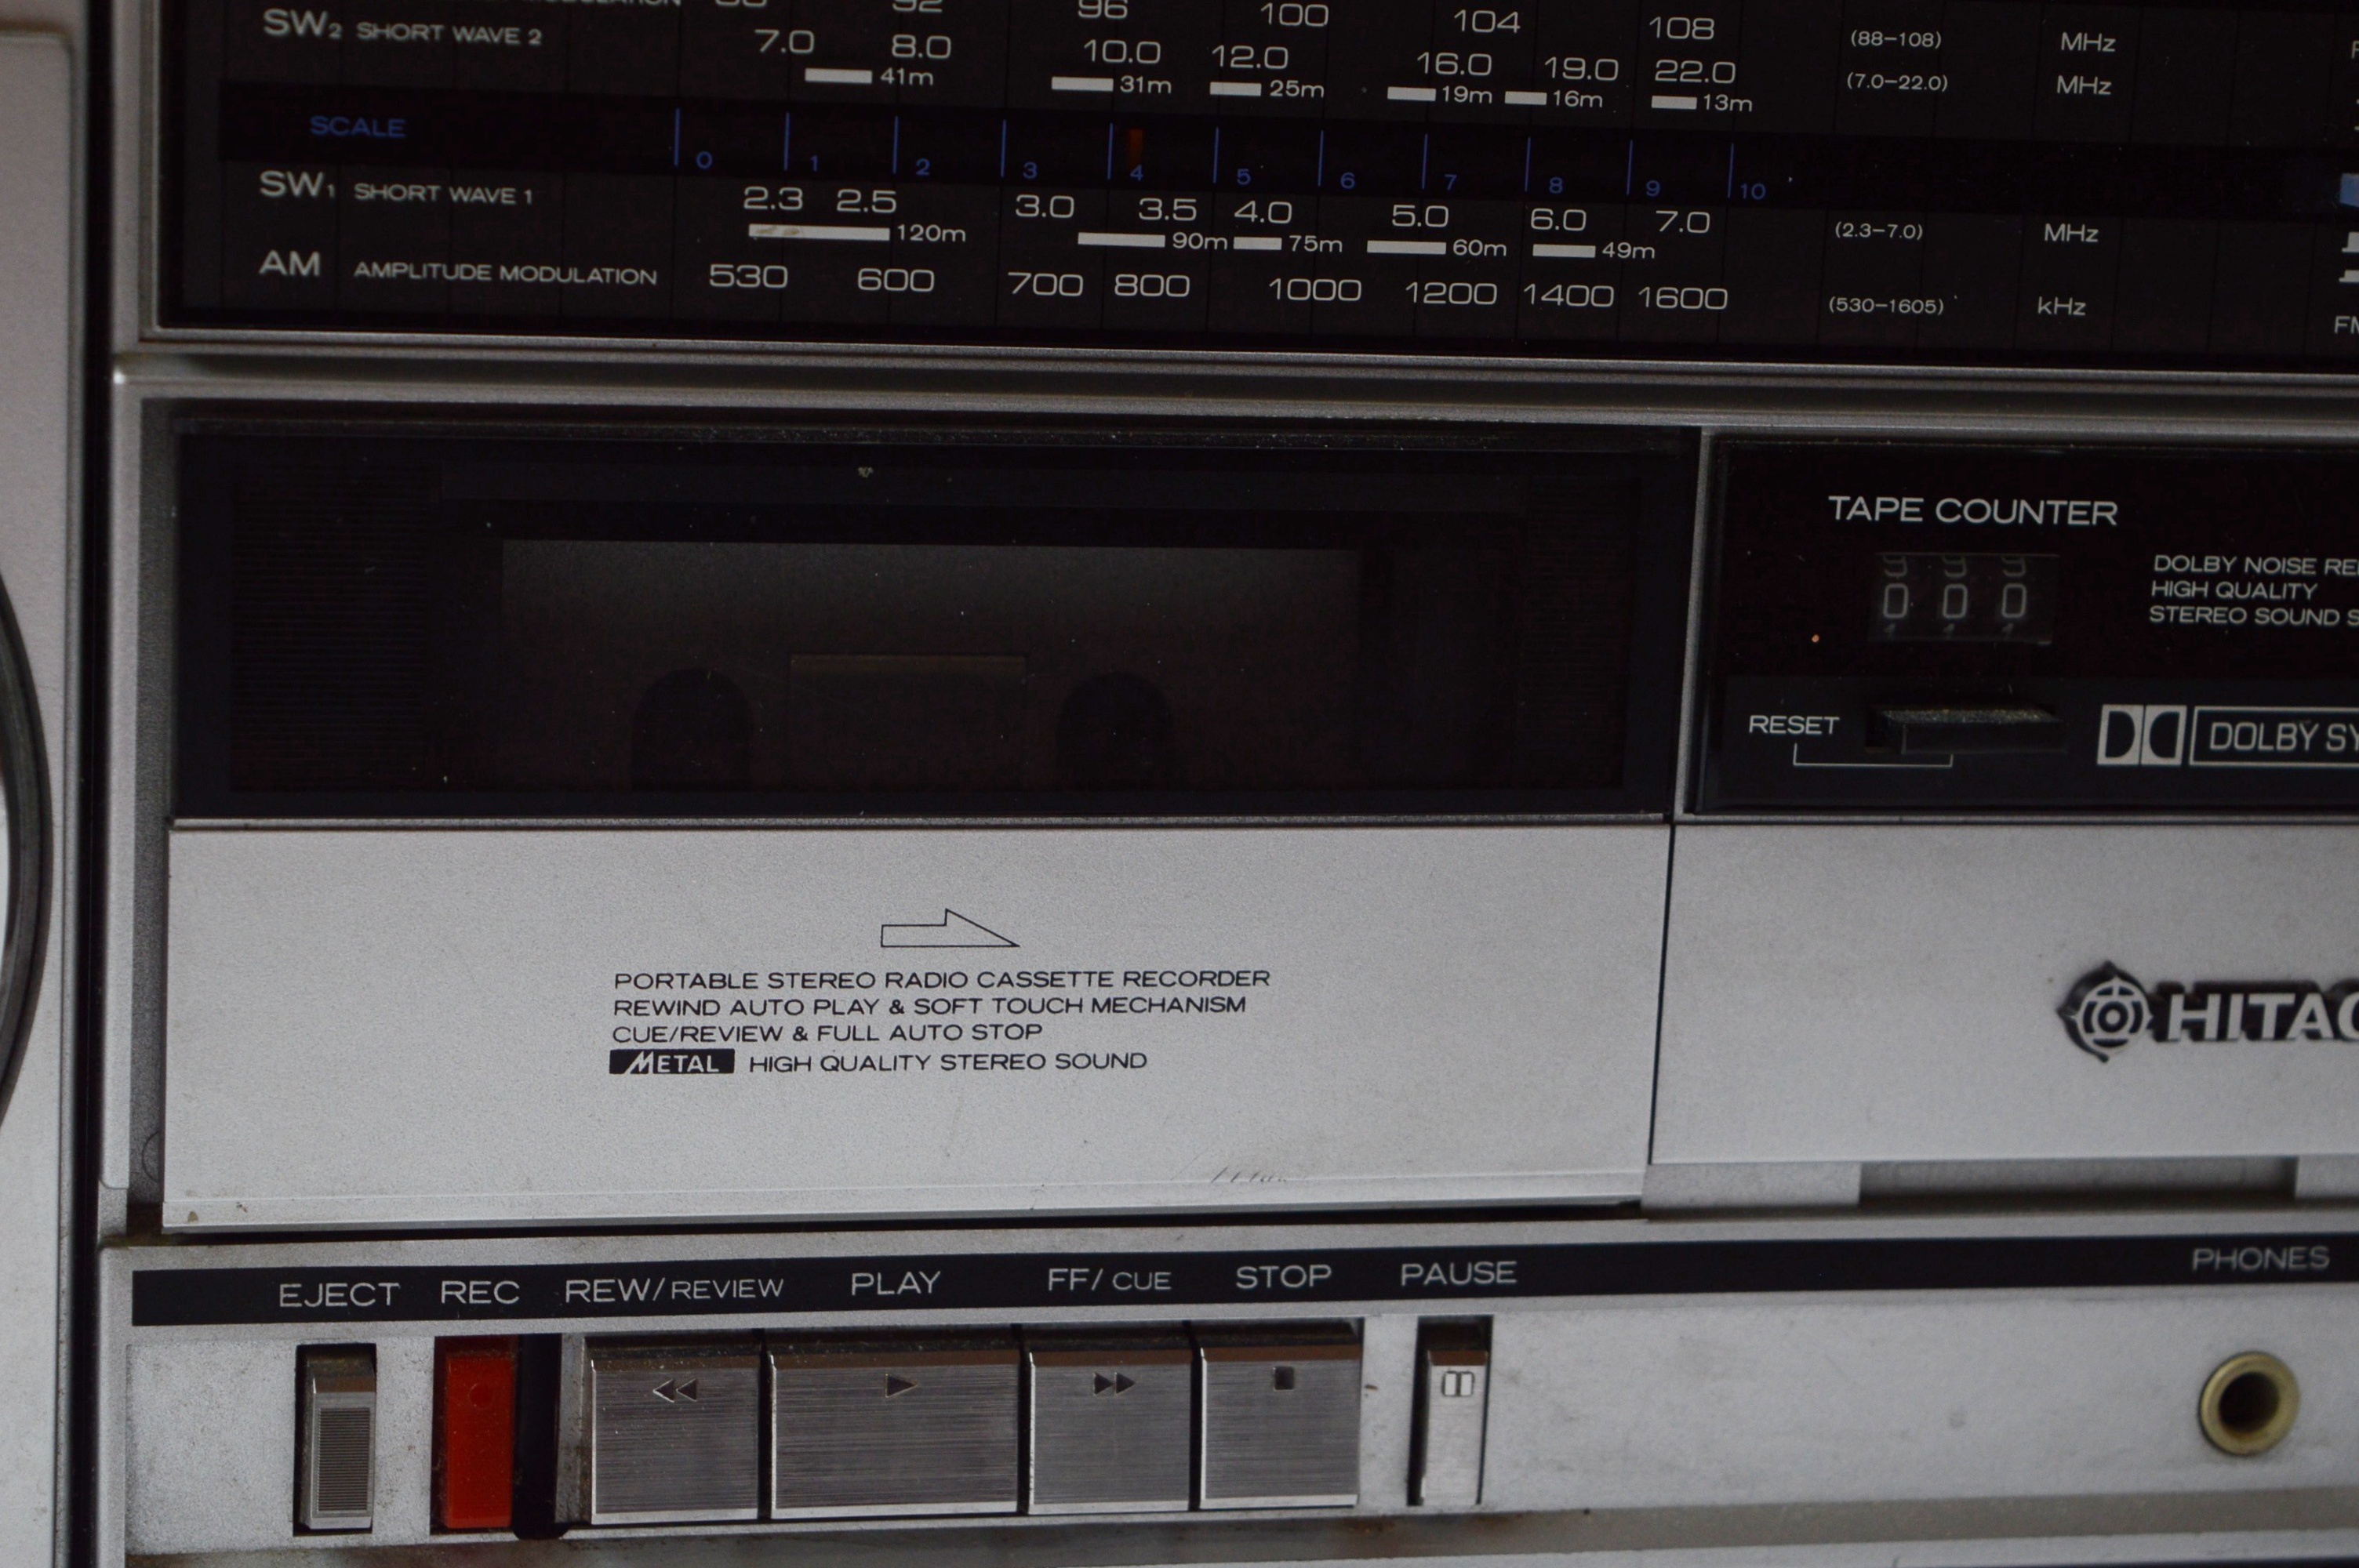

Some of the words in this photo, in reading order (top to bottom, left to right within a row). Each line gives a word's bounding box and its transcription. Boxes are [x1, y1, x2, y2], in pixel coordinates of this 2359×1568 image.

[1078, 0, 1129, 20] 96
[1260, 2, 1329, 27] 100
[1454, 9, 1521, 34] 104
[1649, 16, 1715, 41] 108
[356, 21, 445, 41] SHORT
[453, 26, 520, 45] WAVE
[528, 28, 542, 45] 2
[1851, 29, 1942, 49] (88-108)
[2060, 31, 2116, 53] MHz
[754, 28, 815, 54] 7.0
[891, 34, 952, 60] 8.0
[1084, 38, 1161, 64] 10.0
[1212, 45, 1289, 70] 12.0
[1417, 51, 1492, 77] 16.0
[1544, 56, 1619, 82] 19.0
[1654, 59, 1736, 84] 22.0
[880, 67, 934, 85] 41m
[1120, 74, 1172, 94] 31m
[1270, 79, 1325, 98] 25m
[1442, 85, 1493, 103] 19m
[1554, 89, 1603, 108] 16m
[1703, 93, 1753, 112] 13m
[1847, 71, 1948, 93] (7.0-22.0)
[2056, 74, 2112, 96] MHz
[310, 115, 406, 139] SCALE
[695, 151, 714, 170] 0
[810, 154, 820, 172] 1
[916, 158, 931, 176] 2
[1023, 161, 1038, 180] 3
[1129, 165, 1144, 181] 4
[1237, 168, 1252, 186] 5
[1340, 172, 1356, 190] 6
[1444, 173, 1458, 191] 7
[1548, 176, 1564, 194] 8
[1645, 180, 1662, 198] 9
[1740, 183, 1767, 201] 10
[354, 183, 441, 201] SHORT
[449, 187, 516, 205] WAVE
[524, 189, 532, 204] 1
[743, 185, 803, 211] 2.3
[836, 188, 897, 214] 2.5
[1015, 194, 1075, 219] 3.0
[1138, 197, 1198, 222] 3.5
[1234, 200, 1292, 224] 4.0
[1391, 204, 1449, 228] 5.0
[1530, 207, 1587, 232] 6.0
[1656, 209, 1710, 234] 7.0
[897, 223, 966, 242] 120m
[1172, 231, 1228, 250] 90m
[1289, 234, 1343, 252] 75m
[1452, 238, 1507, 256] 60m
[1601, 241, 1656, 259] 49m
[1835, 221, 1923, 241] (2.3-7.0)
[2044, 223, 2099, 243] MHz
[259, 249, 320, 277] AM
[354, 261, 492, 281] AMPLITUDE
[499, 265, 657, 285] MODULATION
[709, 263, 788, 289] 530
[857, 267, 935, 292] 600
[1008, 271, 1084, 297] 700
[1114, 273, 1190, 298] 800
[1269, 278, 1362, 302] 1000
[1405, 281, 1498, 306] 1200
[1524, 283, 1615, 308] 1400
[1638, 286, 1728, 310] 1600
[1829, 296, 1944, 315] (530-1605)
[2037, 296, 2087, 316] kHz
[1828, 495, 1925, 522] TAPE
[1936, 497, 2118, 526] COUNTER
[2154, 554, 2237, 573] DOLBY
[2244, 556, 2317, 575] NOISE
[2324, 557, 2359, 576] RE
[2151, 580, 2209, 598] HIGH
[2215, 581, 2318, 600] QUALITY
[2149, 604, 2248, 625] STEREO
[2254, 607, 2341, 626] SOUND
[1748, 714, 1840, 735] RESET
[2209, 721, 2319, 752] DOLBY
[614, 972, 759, 990] PORTABLE
[767, 971, 876, 989] STEREO
[885, 971, 969, 989] RADIO
[976, 971, 1114, 989] CASSETTE
[1123, 970, 1270, 988] RECORDER
[613, 999, 721, 1017] REWIND
[729, 998, 805, 1017] AUTO
[813, 998, 880, 1016] PLAY
[889, 999, 905, 1015] &
[914, 997, 983, 1015] SOFT
[991, 996, 1084, 1015] TOUCH
[1091, 996, 1246, 1014] MECHANISM
[612, 1025, 783, 1044] CUE/REVIEW
[792, 1025, 809, 1042] &
[817, 1025, 880, 1042] FULL
[889, 1024, 964, 1042] AUTO
[972, 1022, 1043, 1041] STOP
[628, 1051, 721, 1075] METAL
[749, 1055, 812, 1073] HIGH
[820, 1054, 932, 1073] QUALITY
[940, 1053, 1047, 1072] STEREO
[1055, 1052, 1148, 1070] SOUND
[2192, 1246, 2330, 1271] PHONES
[279, 1282, 401, 1308] EJECT
[441, 1280, 520, 1305] REC
[851, 1271, 941, 1296] PLAY
[1236, 1264, 1332, 1290] STOP
[1401, 1260, 1518, 1287] PAUSE
